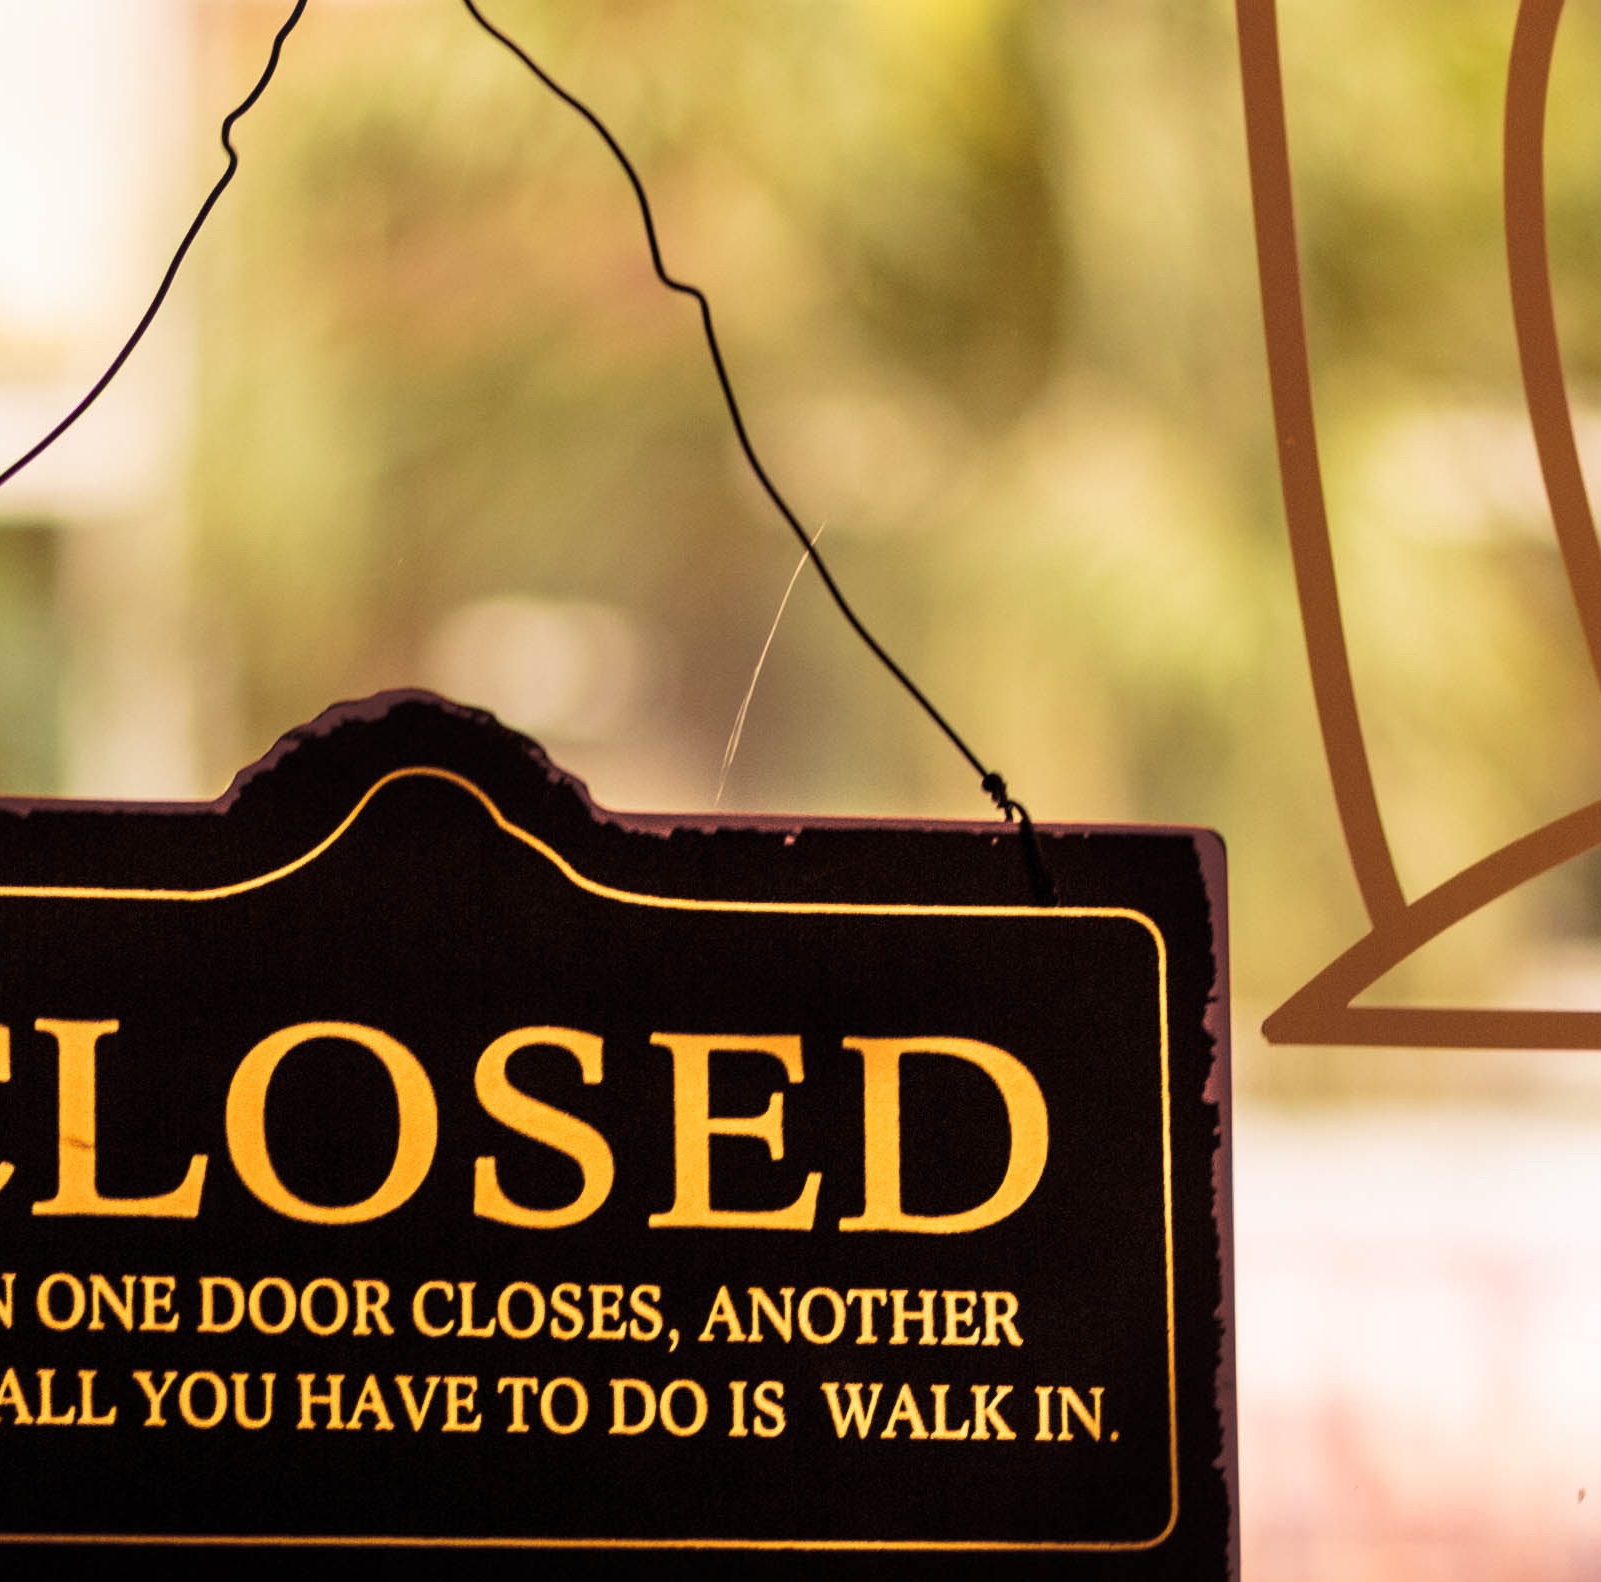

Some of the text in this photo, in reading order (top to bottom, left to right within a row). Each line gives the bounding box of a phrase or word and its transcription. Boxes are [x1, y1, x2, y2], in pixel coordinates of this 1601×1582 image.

[34, 1271, 181, 1333] ONE
[195, 1275, 396, 1338] DOOR
[411, 1279, 681, 1354] CLOSES,
[696, 1284, 1026, 1349] ANOTHER
[131, 1369, 278, 1431] YOU
[295, 1372, 484, 1434] HAVE
[496, 1375, 590, 1436] TO
[607, 1377, 710, 1438] DO
[727, 1379, 788, 1439] IS
[818, 1381, 1018, 1442] WALK
[1033, 1384, 1121, 1443] IN.
